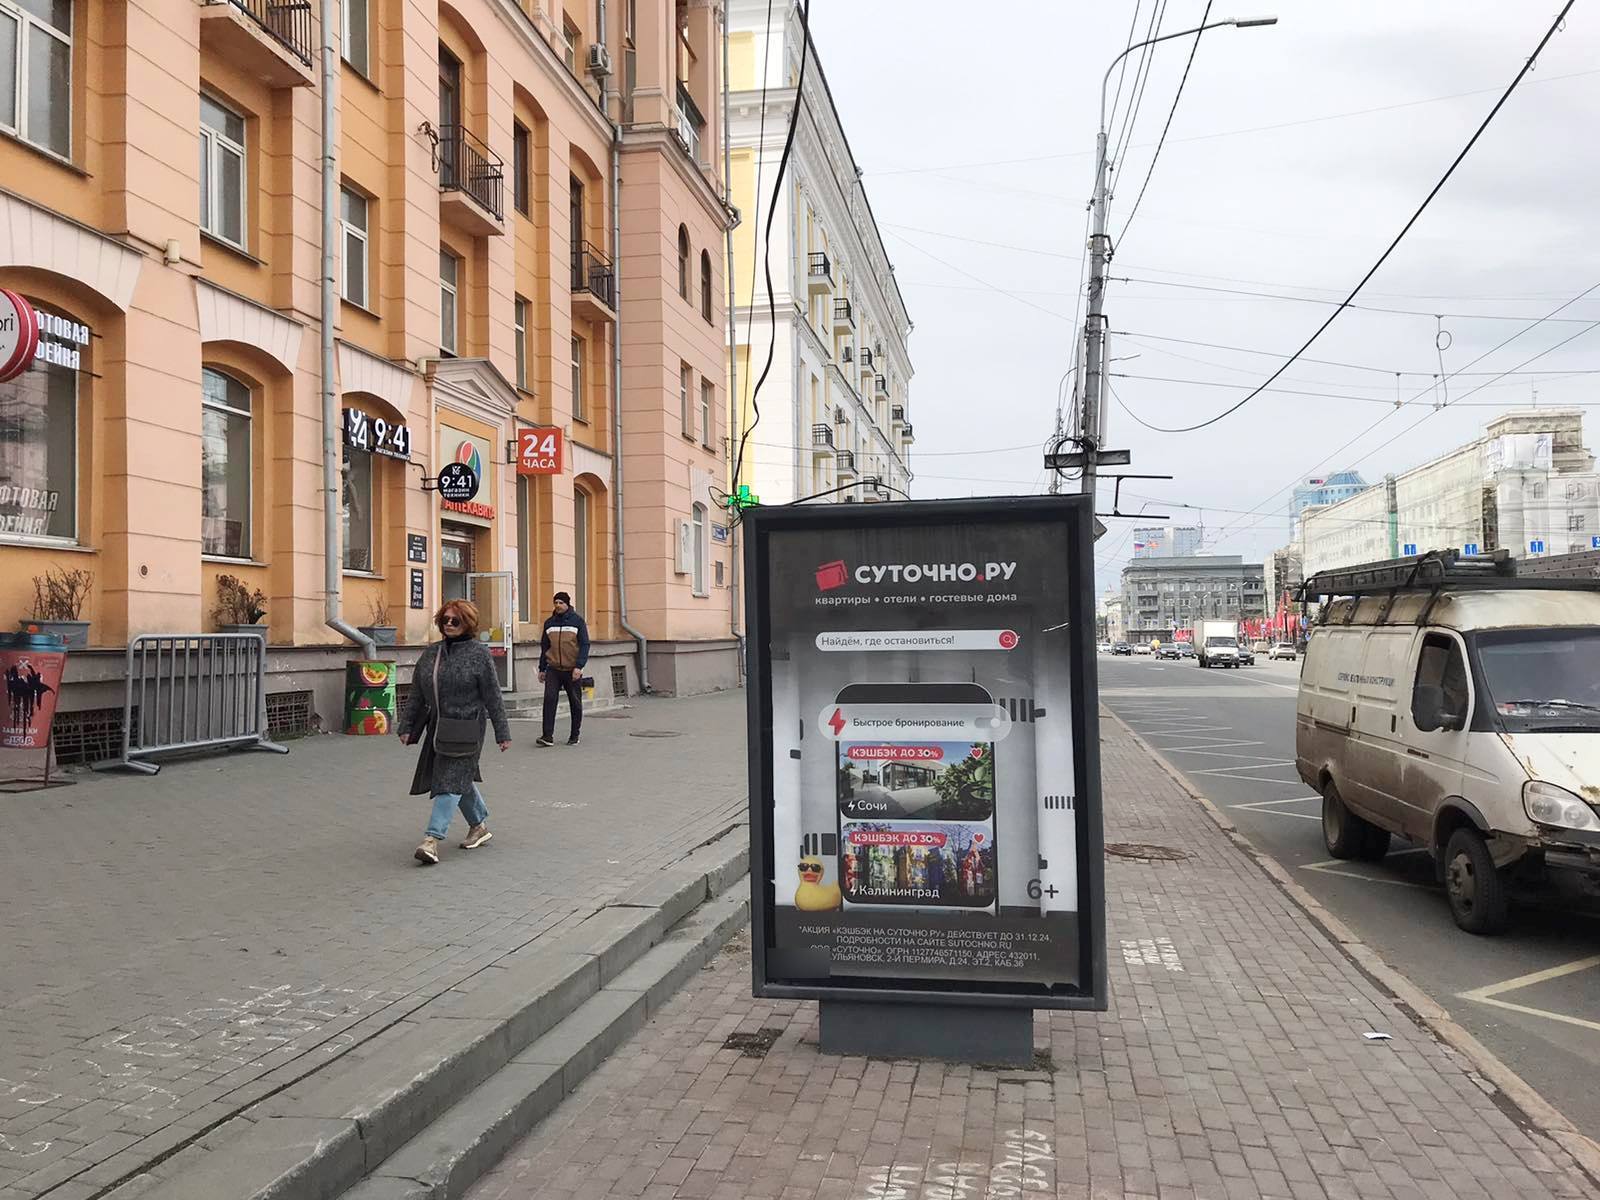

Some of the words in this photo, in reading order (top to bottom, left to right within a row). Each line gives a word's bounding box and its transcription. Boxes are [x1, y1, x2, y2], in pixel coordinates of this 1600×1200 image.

[375, 418, 411, 454] 9:41
[523, 434, 557, 457] 24
[523, 458, 556, 469] ЧАСА
[441, 475, 473, 488] 9:41
[855, 562, 1017, 584] СУТОЧНО.РУ
[815, 596, 871, 606] квартиры
[883, 595, 917, 604] отели
[929, 593, 984, 602] гостевые
[987, 593, 1017, 603] дома
[821, 636, 863, 647] Найдём,
[865, 637, 881, 647] где
[884, 635, 955, 646] остановиться!
[853, 718, 893, 728] Быстрое
[895, 717, 965, 728] бронирование
[852, 748, 897, 757] КЭШБЭК
[900, 748, 915, 758] ДО
[918, 749, 939, 758] 30%
[857, 800, 888, 811] Сочи
[854, 833, 900, 842] КЭШБЭК
[902, 834, 918, 843] ДО
[920, 835, 941, 844] 30%
[859, 885, 940, 899] Калининград
[1027, 878, 1059, 900] 6+
[836, 935, 901, 945] ПОДРОБНОСТИ
[903, 938, 916, 946] НА
[917, 938, 946, 947] САЙТЕ
[873, 928, 886, 936] НА
[947, 929, 999, 939] ДЕЙСТВУЕТ
[1000, 932, 1014, 942] ДО
[886, 947, 910, 956] ОГРН
[976, 950, 1007, 960] АДРЕС
